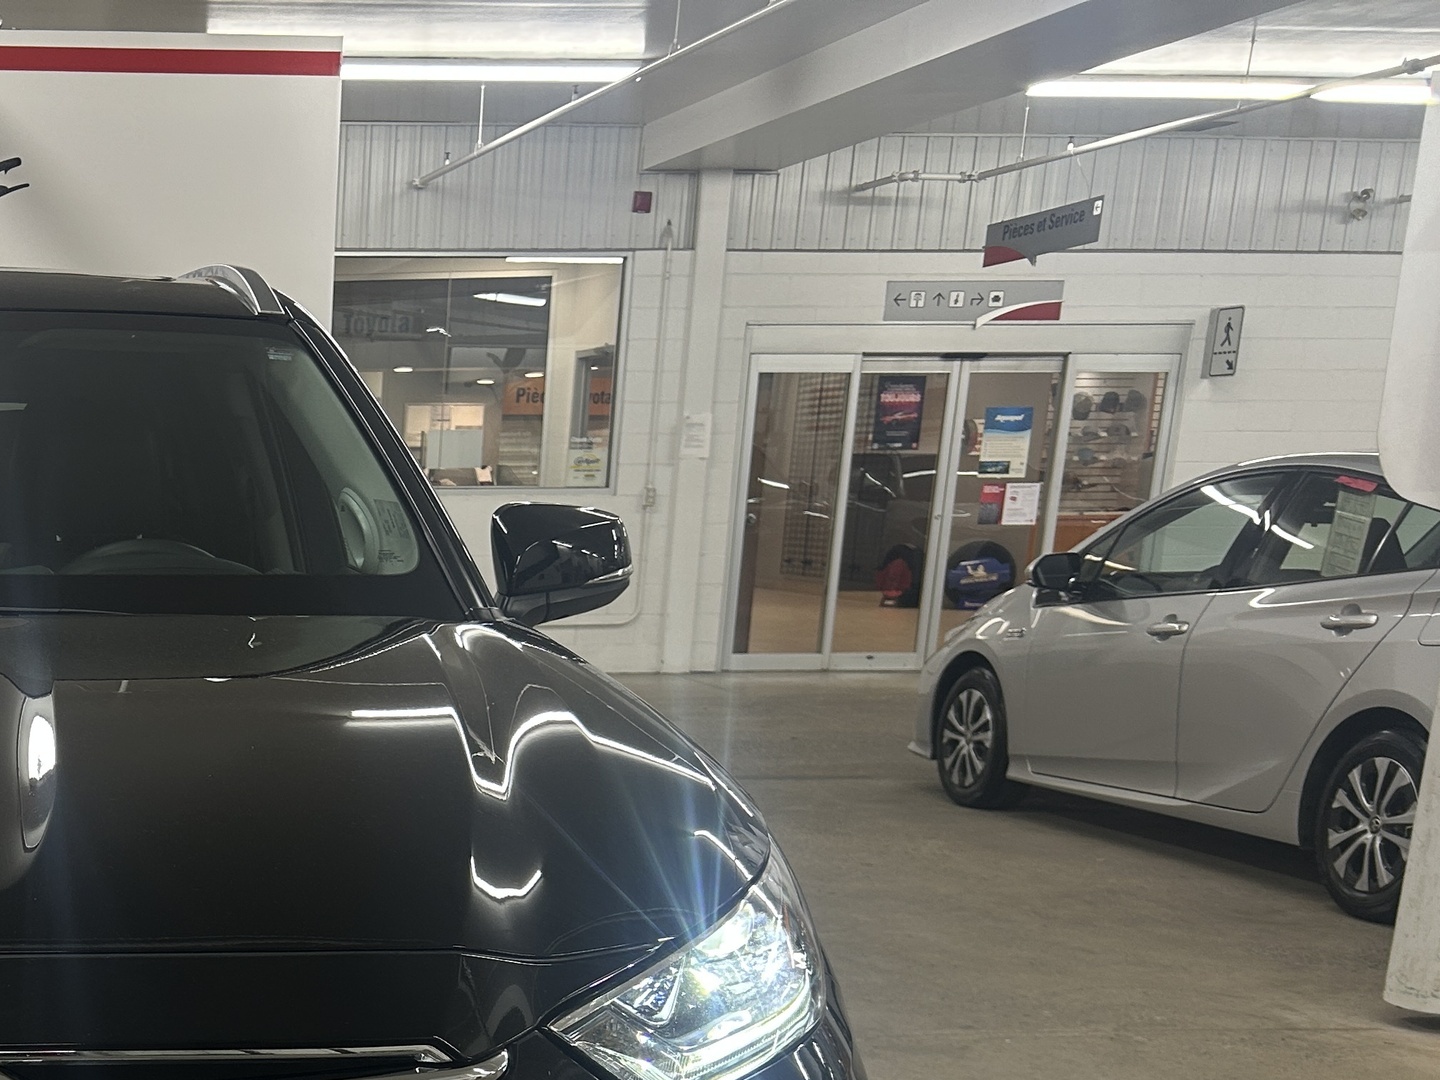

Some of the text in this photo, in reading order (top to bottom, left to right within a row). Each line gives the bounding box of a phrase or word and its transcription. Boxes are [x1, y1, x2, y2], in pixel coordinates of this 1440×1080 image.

[1002, 208, 1086, 241] Pièces et Service
